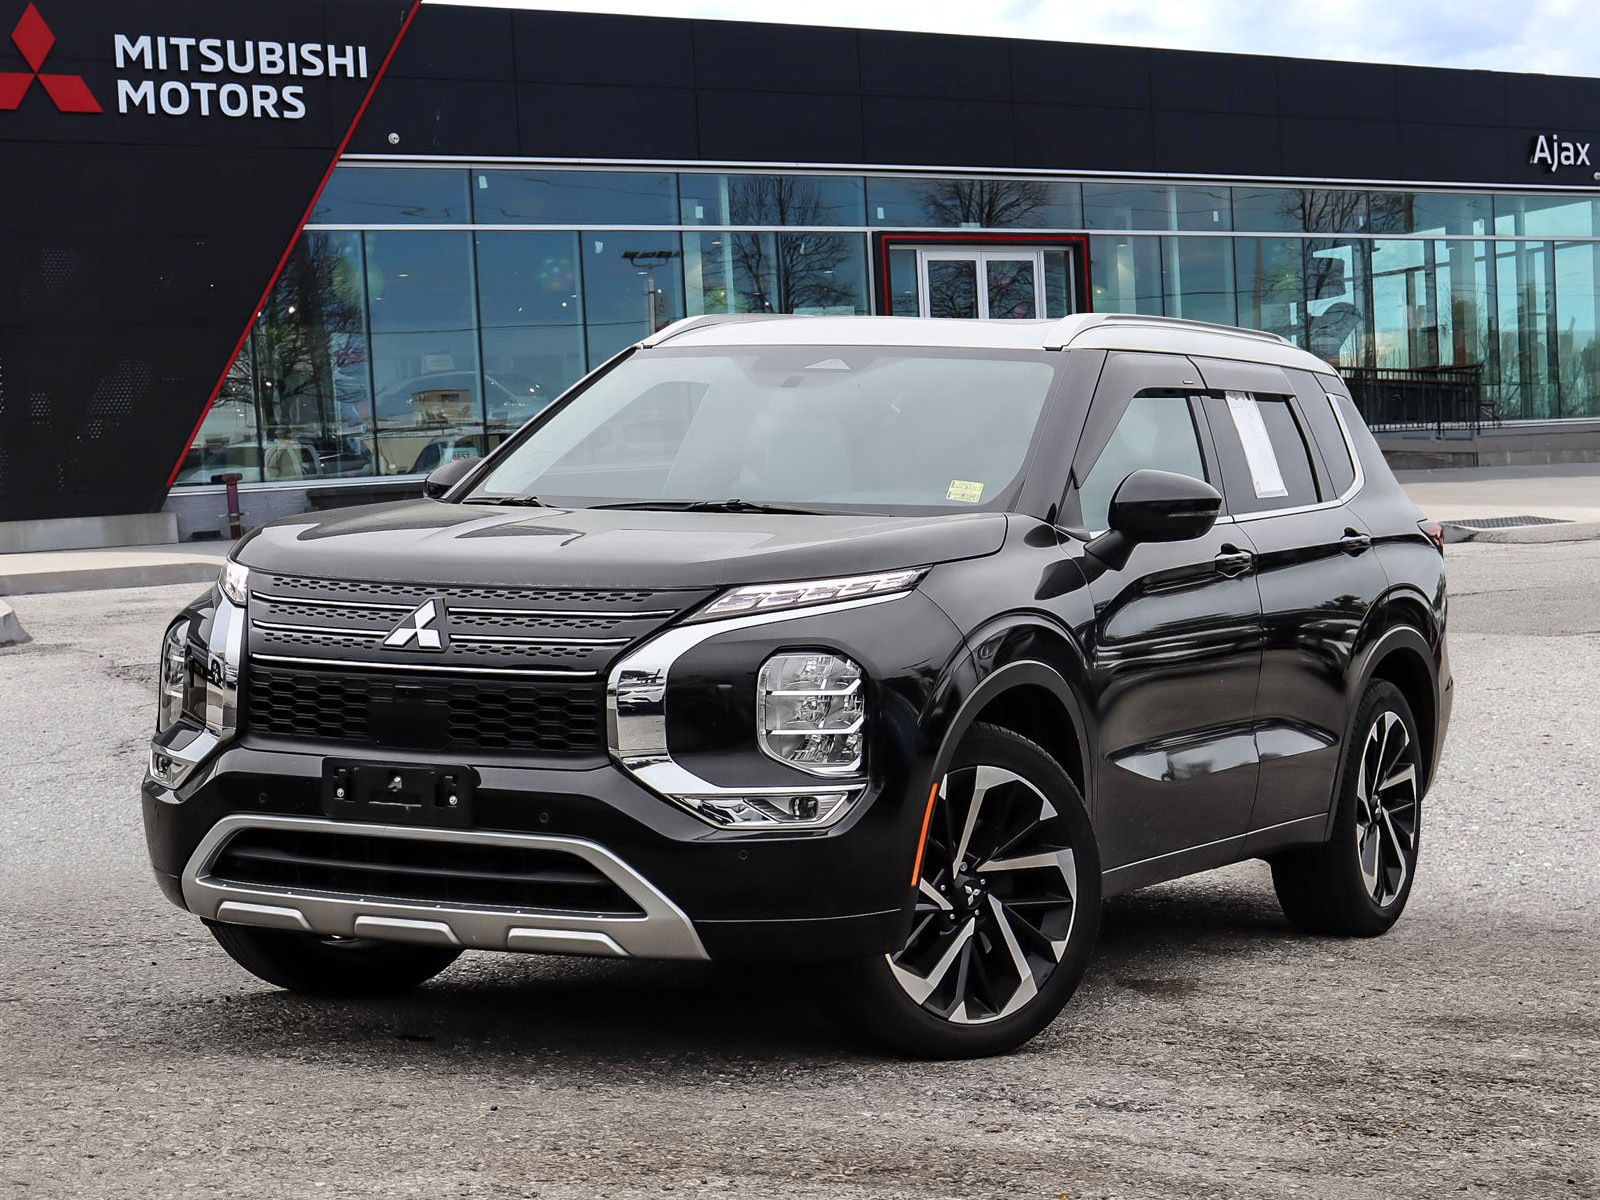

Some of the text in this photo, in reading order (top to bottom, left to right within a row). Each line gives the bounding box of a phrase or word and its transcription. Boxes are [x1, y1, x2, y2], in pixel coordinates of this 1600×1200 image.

[114, 33, 368, 78] MITSUBISHI
[117, 79, 306, 119] MOTORS
[1532, 134, 1591, 173] Ajax
